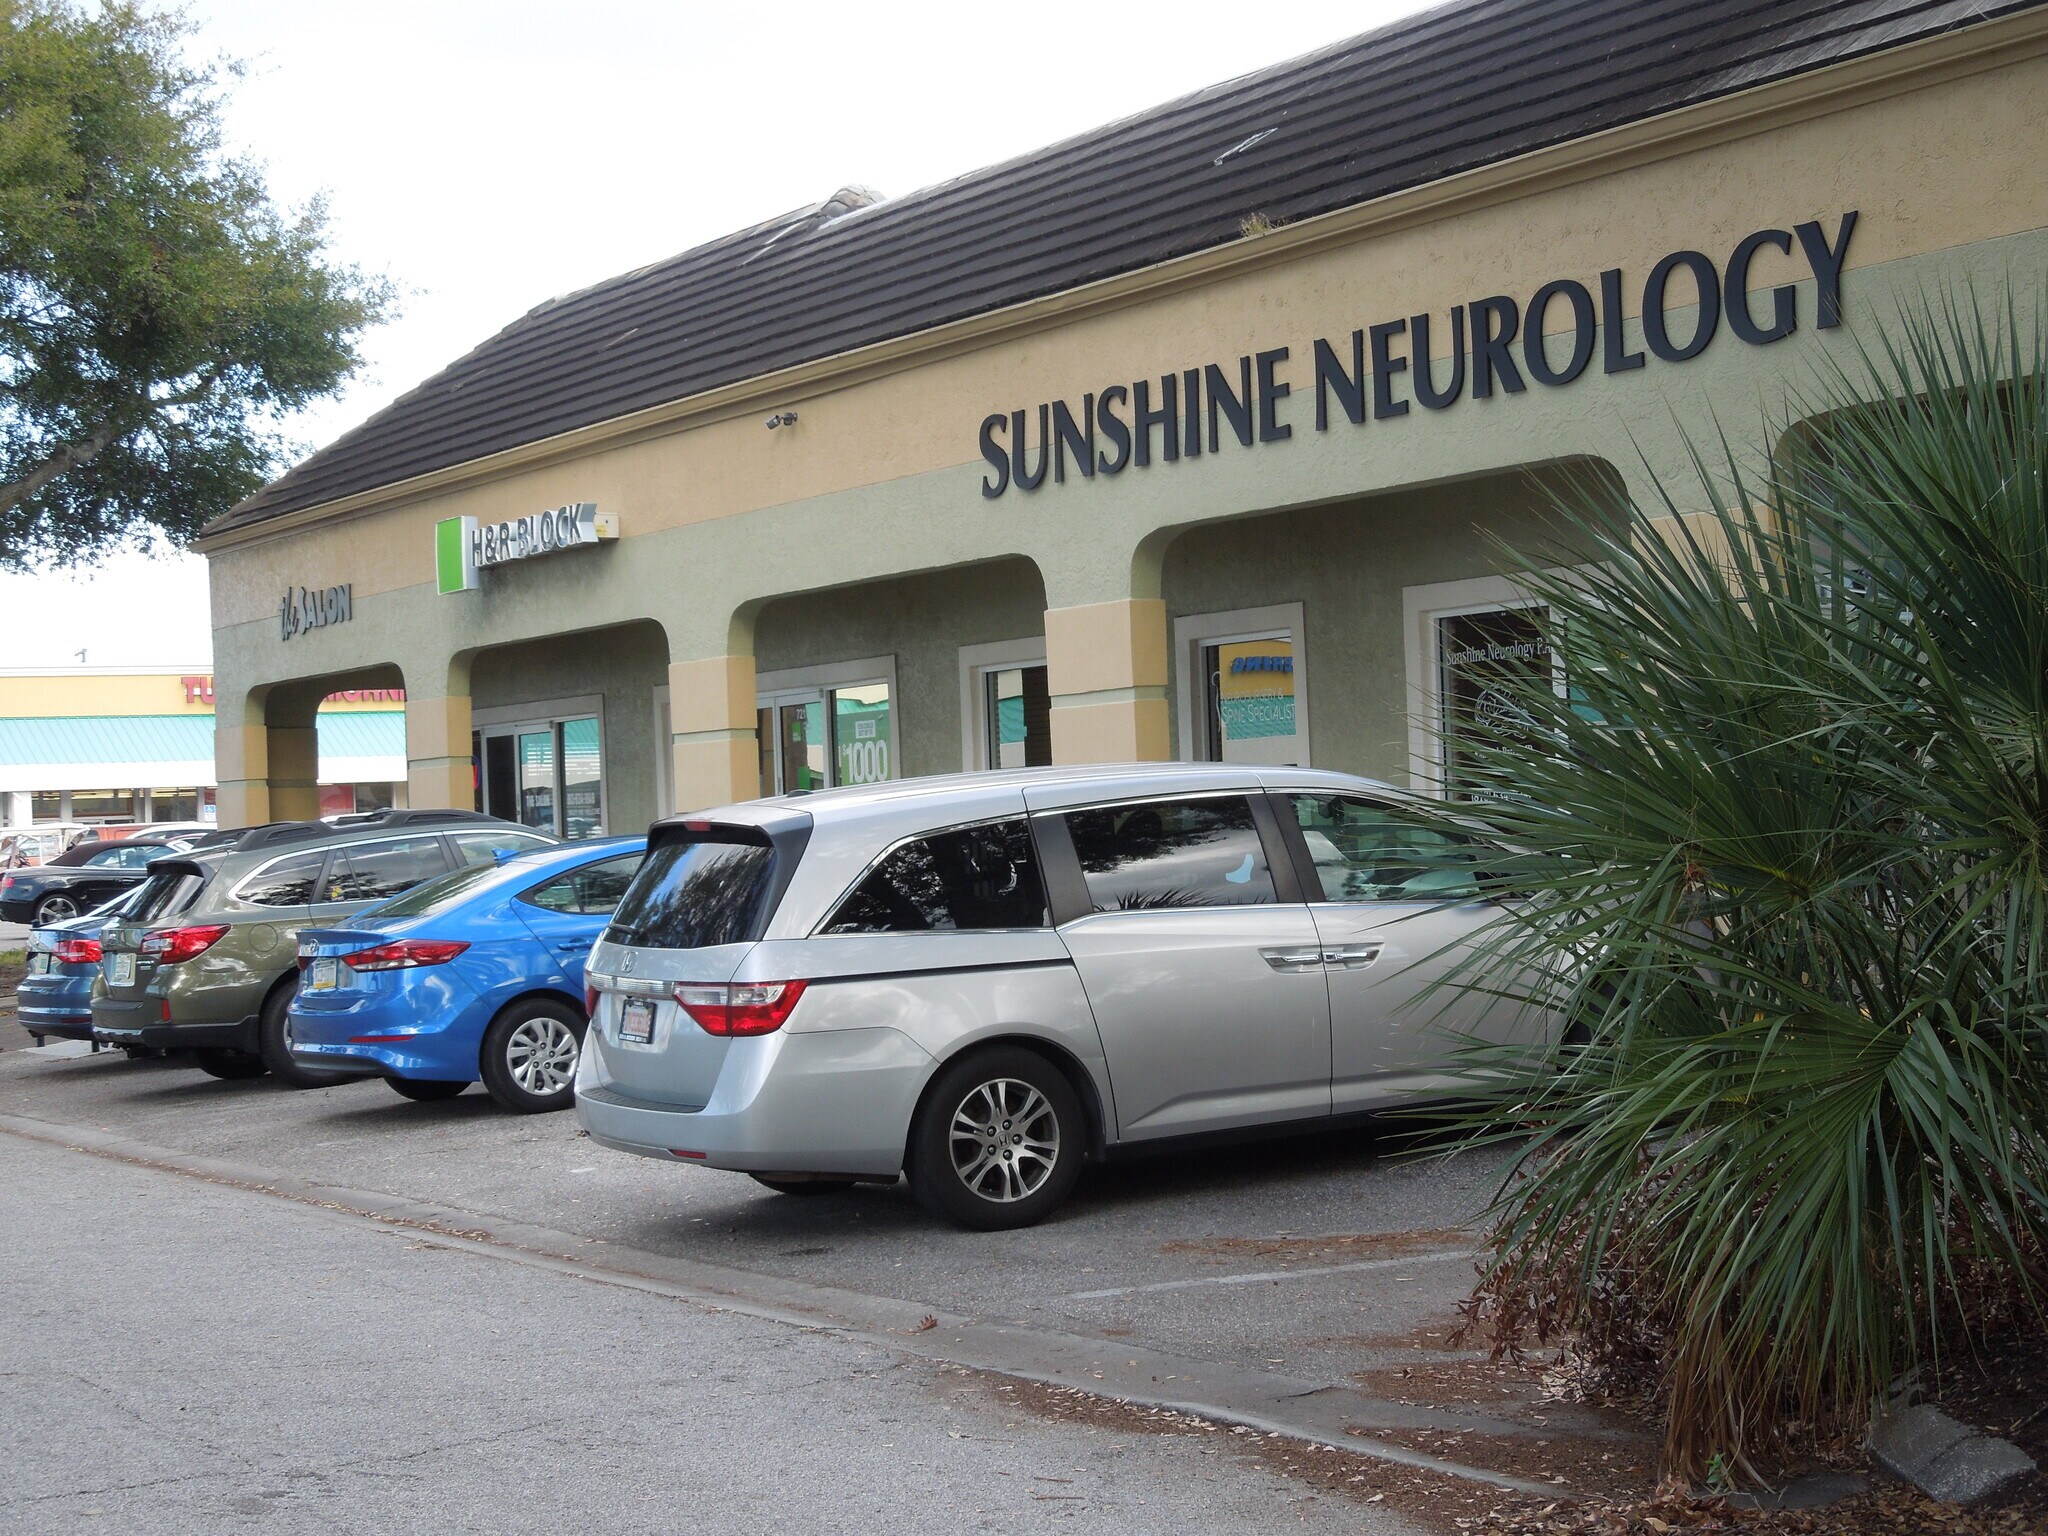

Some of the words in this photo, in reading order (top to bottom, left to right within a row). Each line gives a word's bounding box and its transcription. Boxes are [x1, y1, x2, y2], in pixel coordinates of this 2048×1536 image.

[980, 346, 1291, 499] SUNSHINE
[1315, 210, 1858, 431] NEUROLOGY
[472, 521, 511, 567] H&R
[517, 502, 584, 557] BLOCK
[299, 583, 352, 635] SALON
[1446, 645, 1486, 666] Sunshine
[1487, 638, 1534, 662] Neurology
